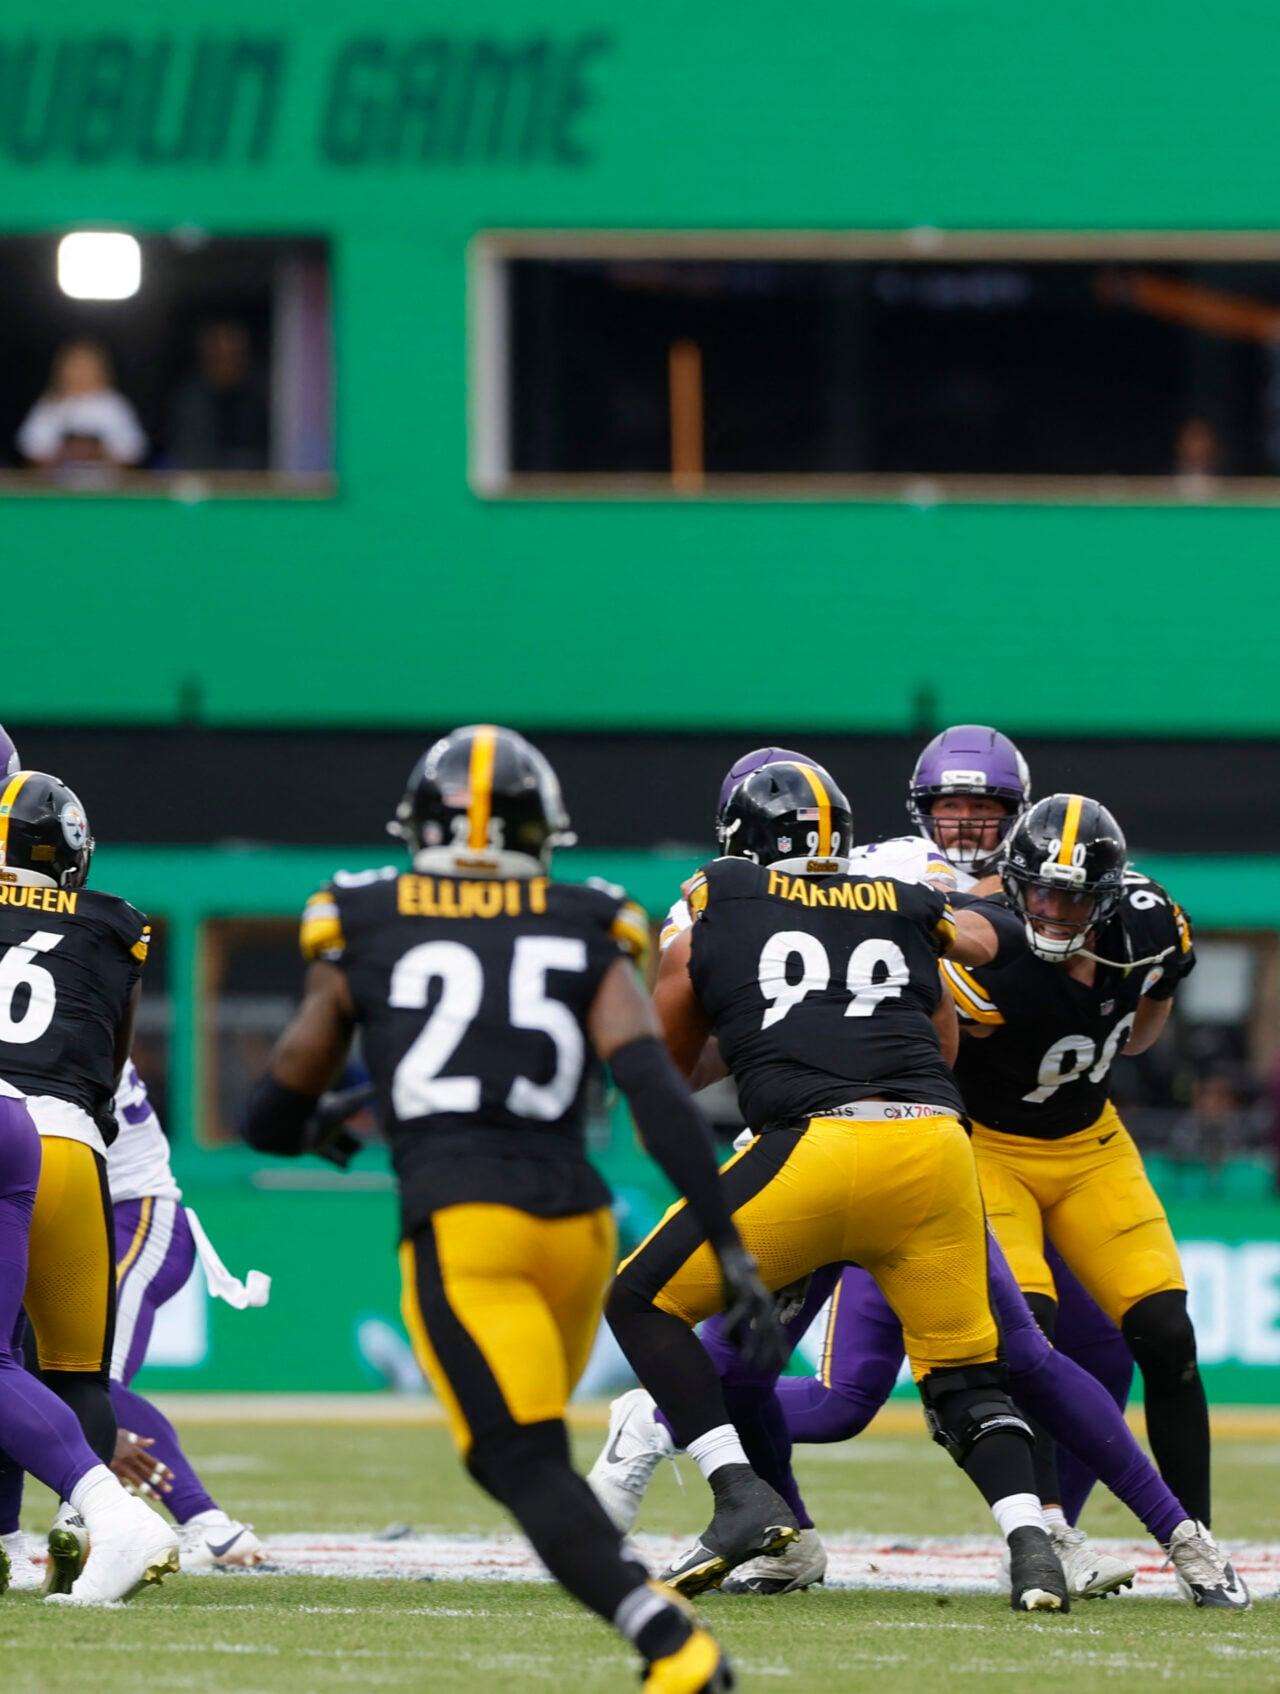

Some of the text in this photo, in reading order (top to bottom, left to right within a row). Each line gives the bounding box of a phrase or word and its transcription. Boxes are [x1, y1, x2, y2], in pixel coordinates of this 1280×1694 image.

[322, 34, 614, 168] GAME
[806, 831, 841, 857] 99
[1047, 839, 1087, 868] 90
[768, 870, 898, 912] HARMON
[758, 930, 910, 1031] 99
[387, 934, 587, 1122] 25
